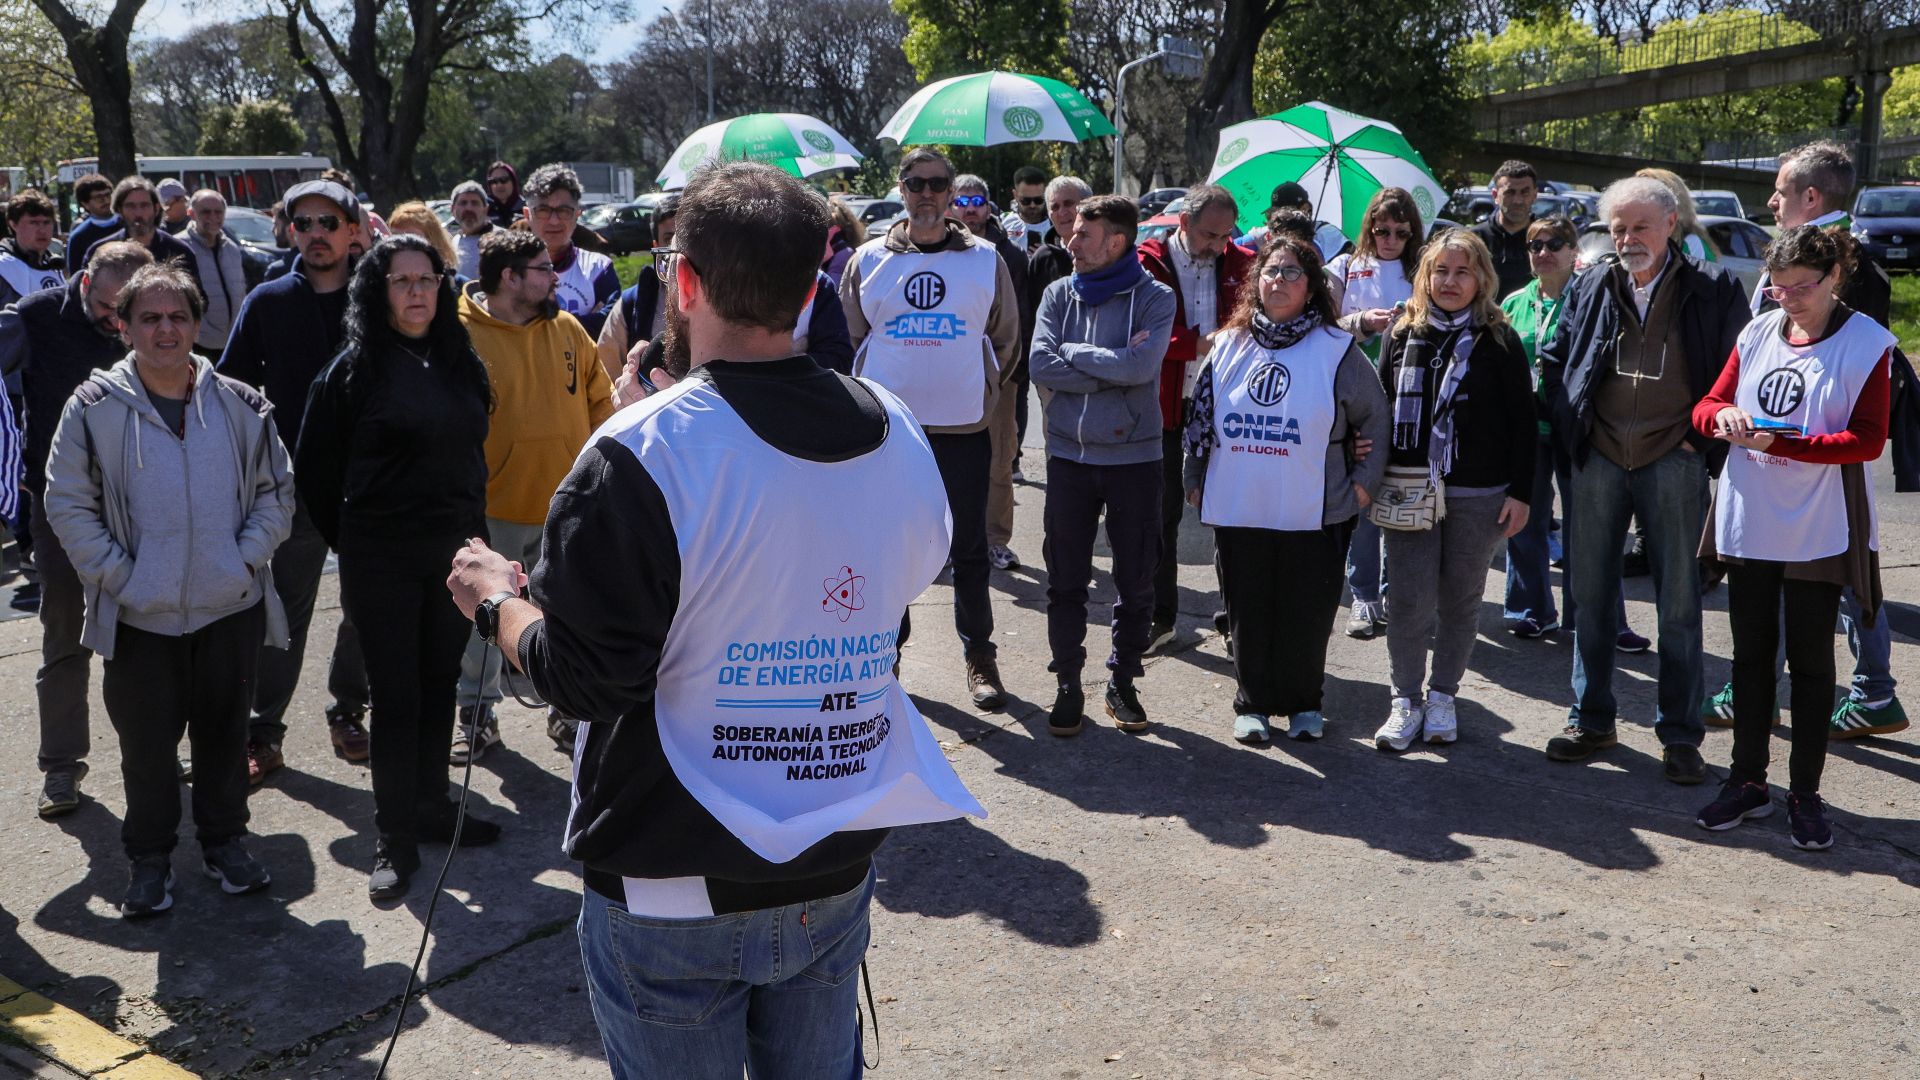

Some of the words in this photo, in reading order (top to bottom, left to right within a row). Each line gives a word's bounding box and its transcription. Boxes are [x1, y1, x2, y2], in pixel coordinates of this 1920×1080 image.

[942, 108, 968, 116] CASA
[927, 129, 969, 138] MONEDA
[906, 273, 943, 308] ATE
[897, 316, 954, 335] CNEA
[904, 339, 914, 347] EN
[915, 339, 942, 347] LUCHA
[1250, 364, 1289, 405] ATE
[1759, 370, 1803, 415] ATE
[1222, 412, 1302, 445] CNEA
[1231, 445, 1245, 453] en
[1247, 444, 1289, 457] LUCHA
[1747, 452, 1757, 461] EN
[1759, 455, 1788, 467] LUCHA
[727, 634, 836, 662] COMISIÓN
[718, 665, 752, 686] DE
[756, 658, 854, 686] ENERGÍA
[819, 691, 858, 712] ATE
[712, 723, 824, 743] SOBERANÍA
[712, 743, 824, 762] AUTONOMÍA
[786, 757, 867, 781] NACIONAL
